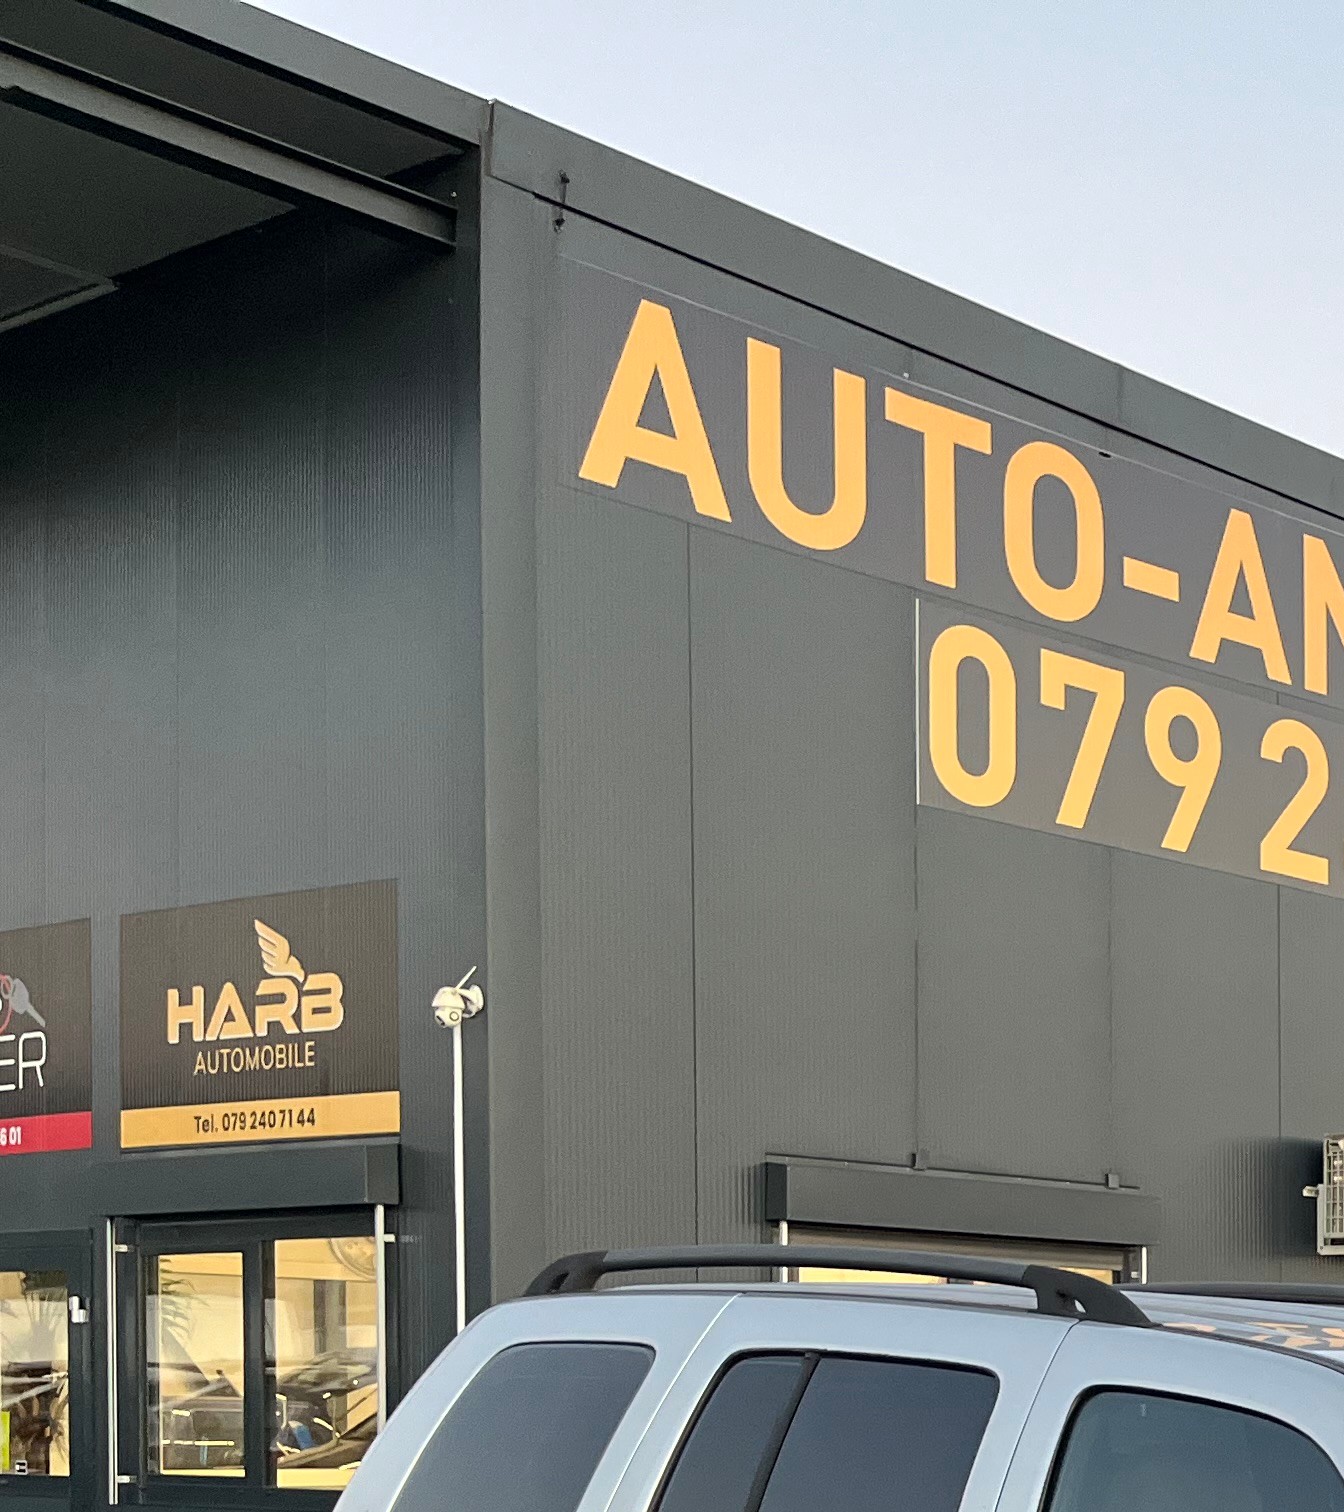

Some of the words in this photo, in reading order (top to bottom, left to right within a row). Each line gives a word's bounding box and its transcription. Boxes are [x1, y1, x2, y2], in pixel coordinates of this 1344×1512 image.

[930, 625, 1222, 853] 079
[167, 972, 344, 1045] HARB
[193, 1041, 316, 1076] AUTOMOBILE
[194, 1113, 219, 1134] Tel.
[222, 1112, 247, 1132] 079
[250, 1110, 276, 1130] 240
